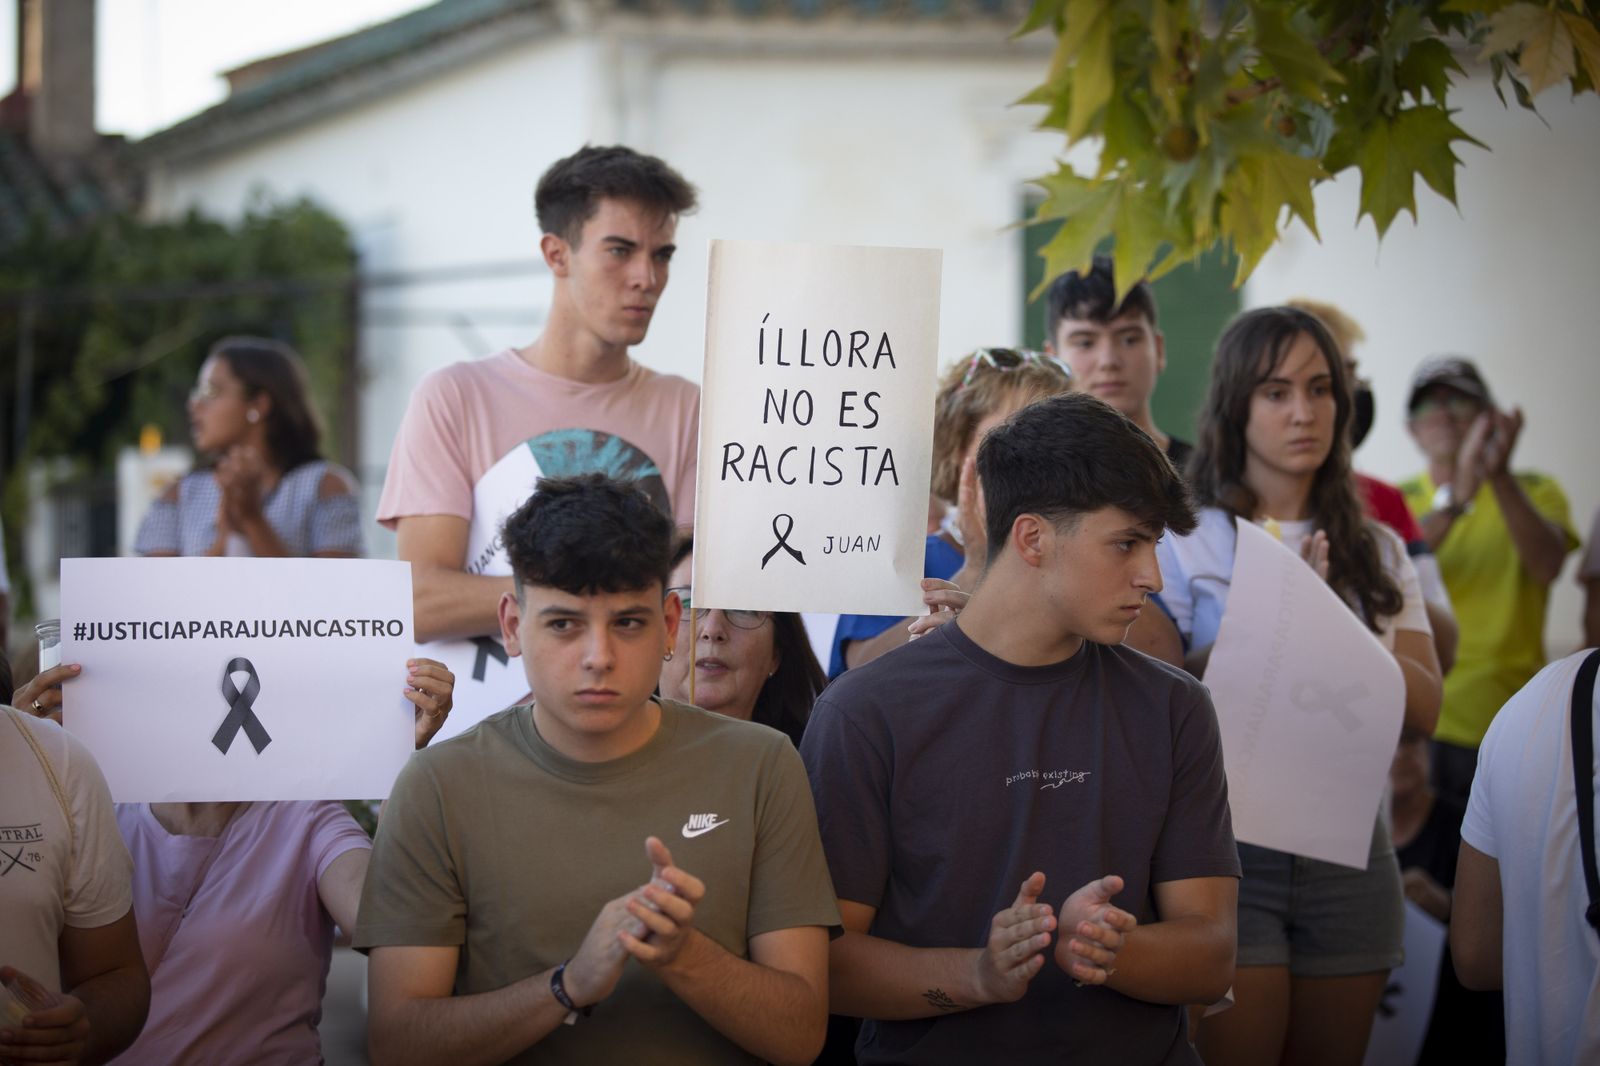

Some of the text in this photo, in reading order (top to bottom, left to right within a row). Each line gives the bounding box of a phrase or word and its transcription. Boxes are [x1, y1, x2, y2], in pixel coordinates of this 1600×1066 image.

[757, 312, 897, 370] ÍLLORA
[762, 388, 882, 429] NO ES
[721, 441, 900, 487] RACISTA
[822, 533, 881, 555] JUAN
[73, 617, 405, 642] #JUSTICIAPARAJUANCASTRO
[688, 813, 718, 829] NIKE
